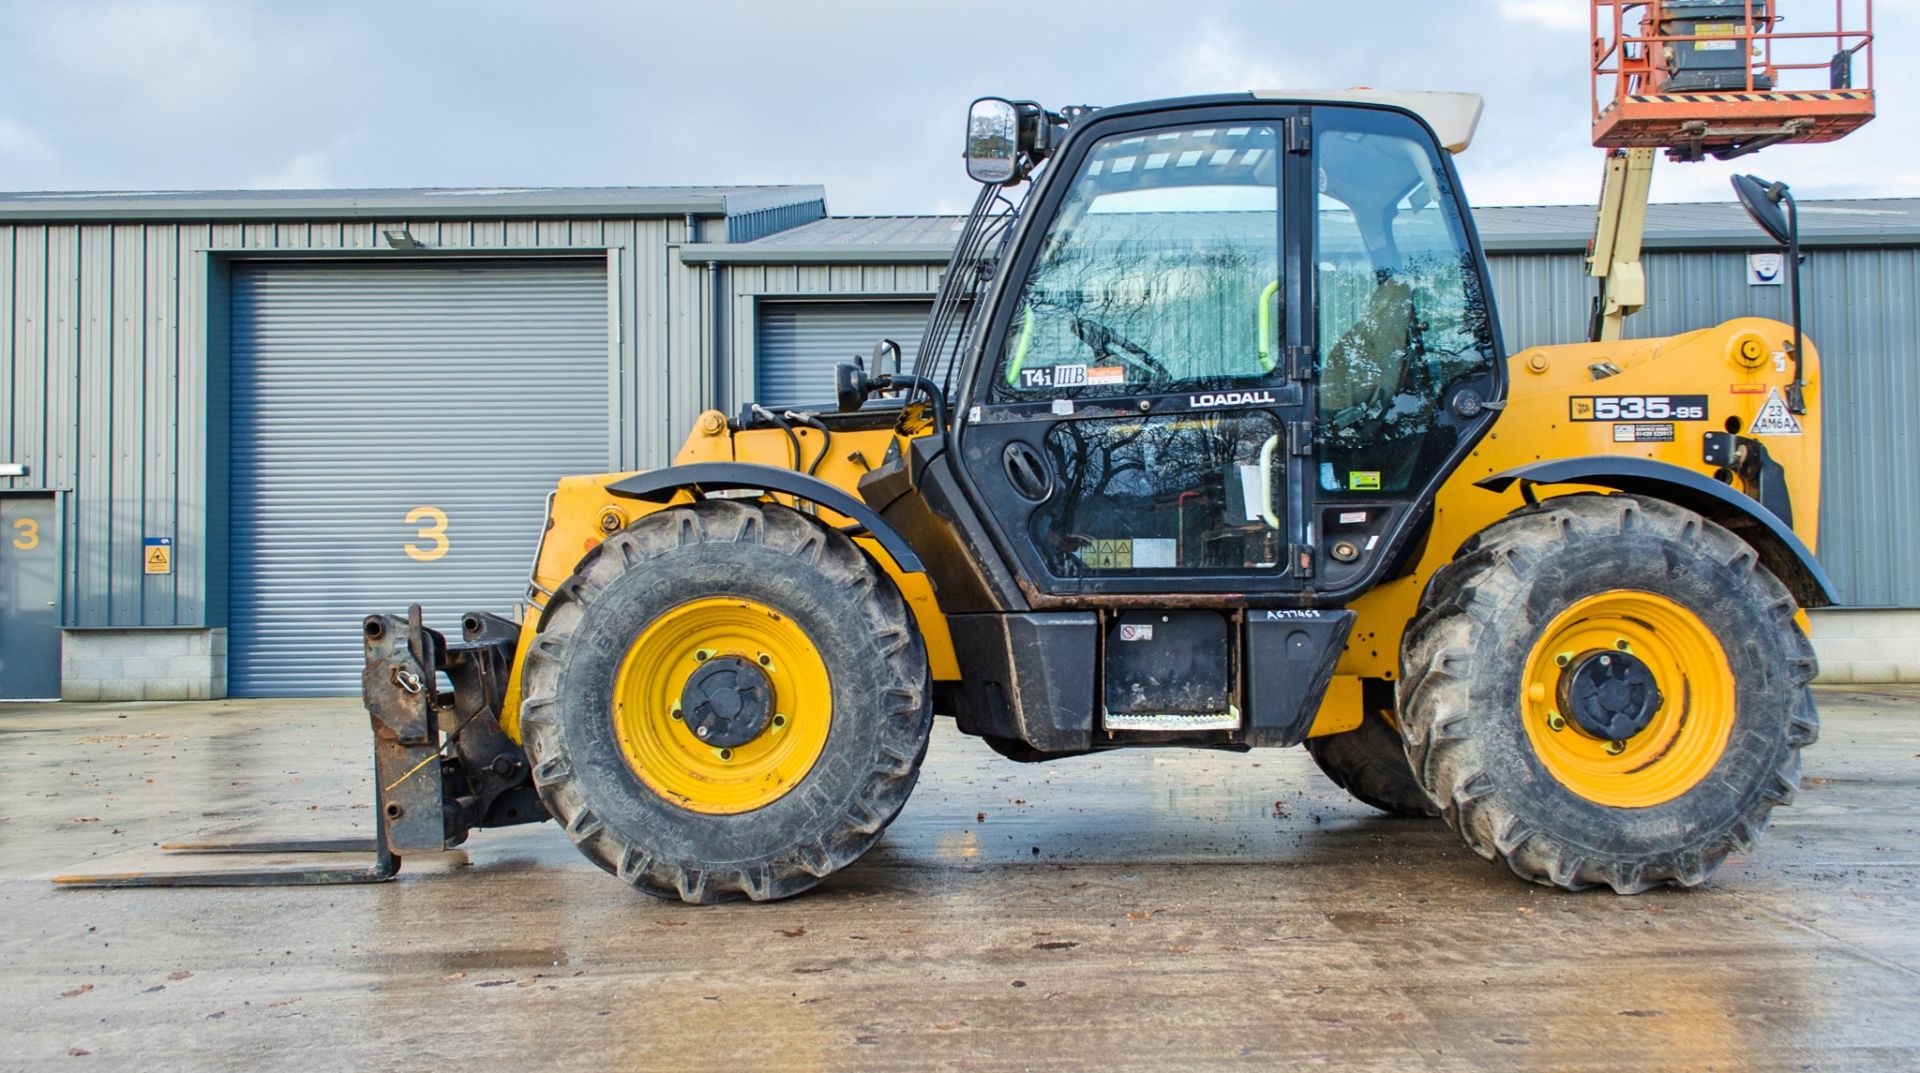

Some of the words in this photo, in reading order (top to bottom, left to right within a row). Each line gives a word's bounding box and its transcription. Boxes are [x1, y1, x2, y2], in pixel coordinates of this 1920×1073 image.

[1022, 369, 1053, 387] T4i
[1190, 392, 1275, 408] LOADALL
[1768, 405, 1782, 417] 23
[1760, 417, 1791, 429] AM6A
[12, 518, 40, 550] 3
[403, 506, 450, 561] 3
